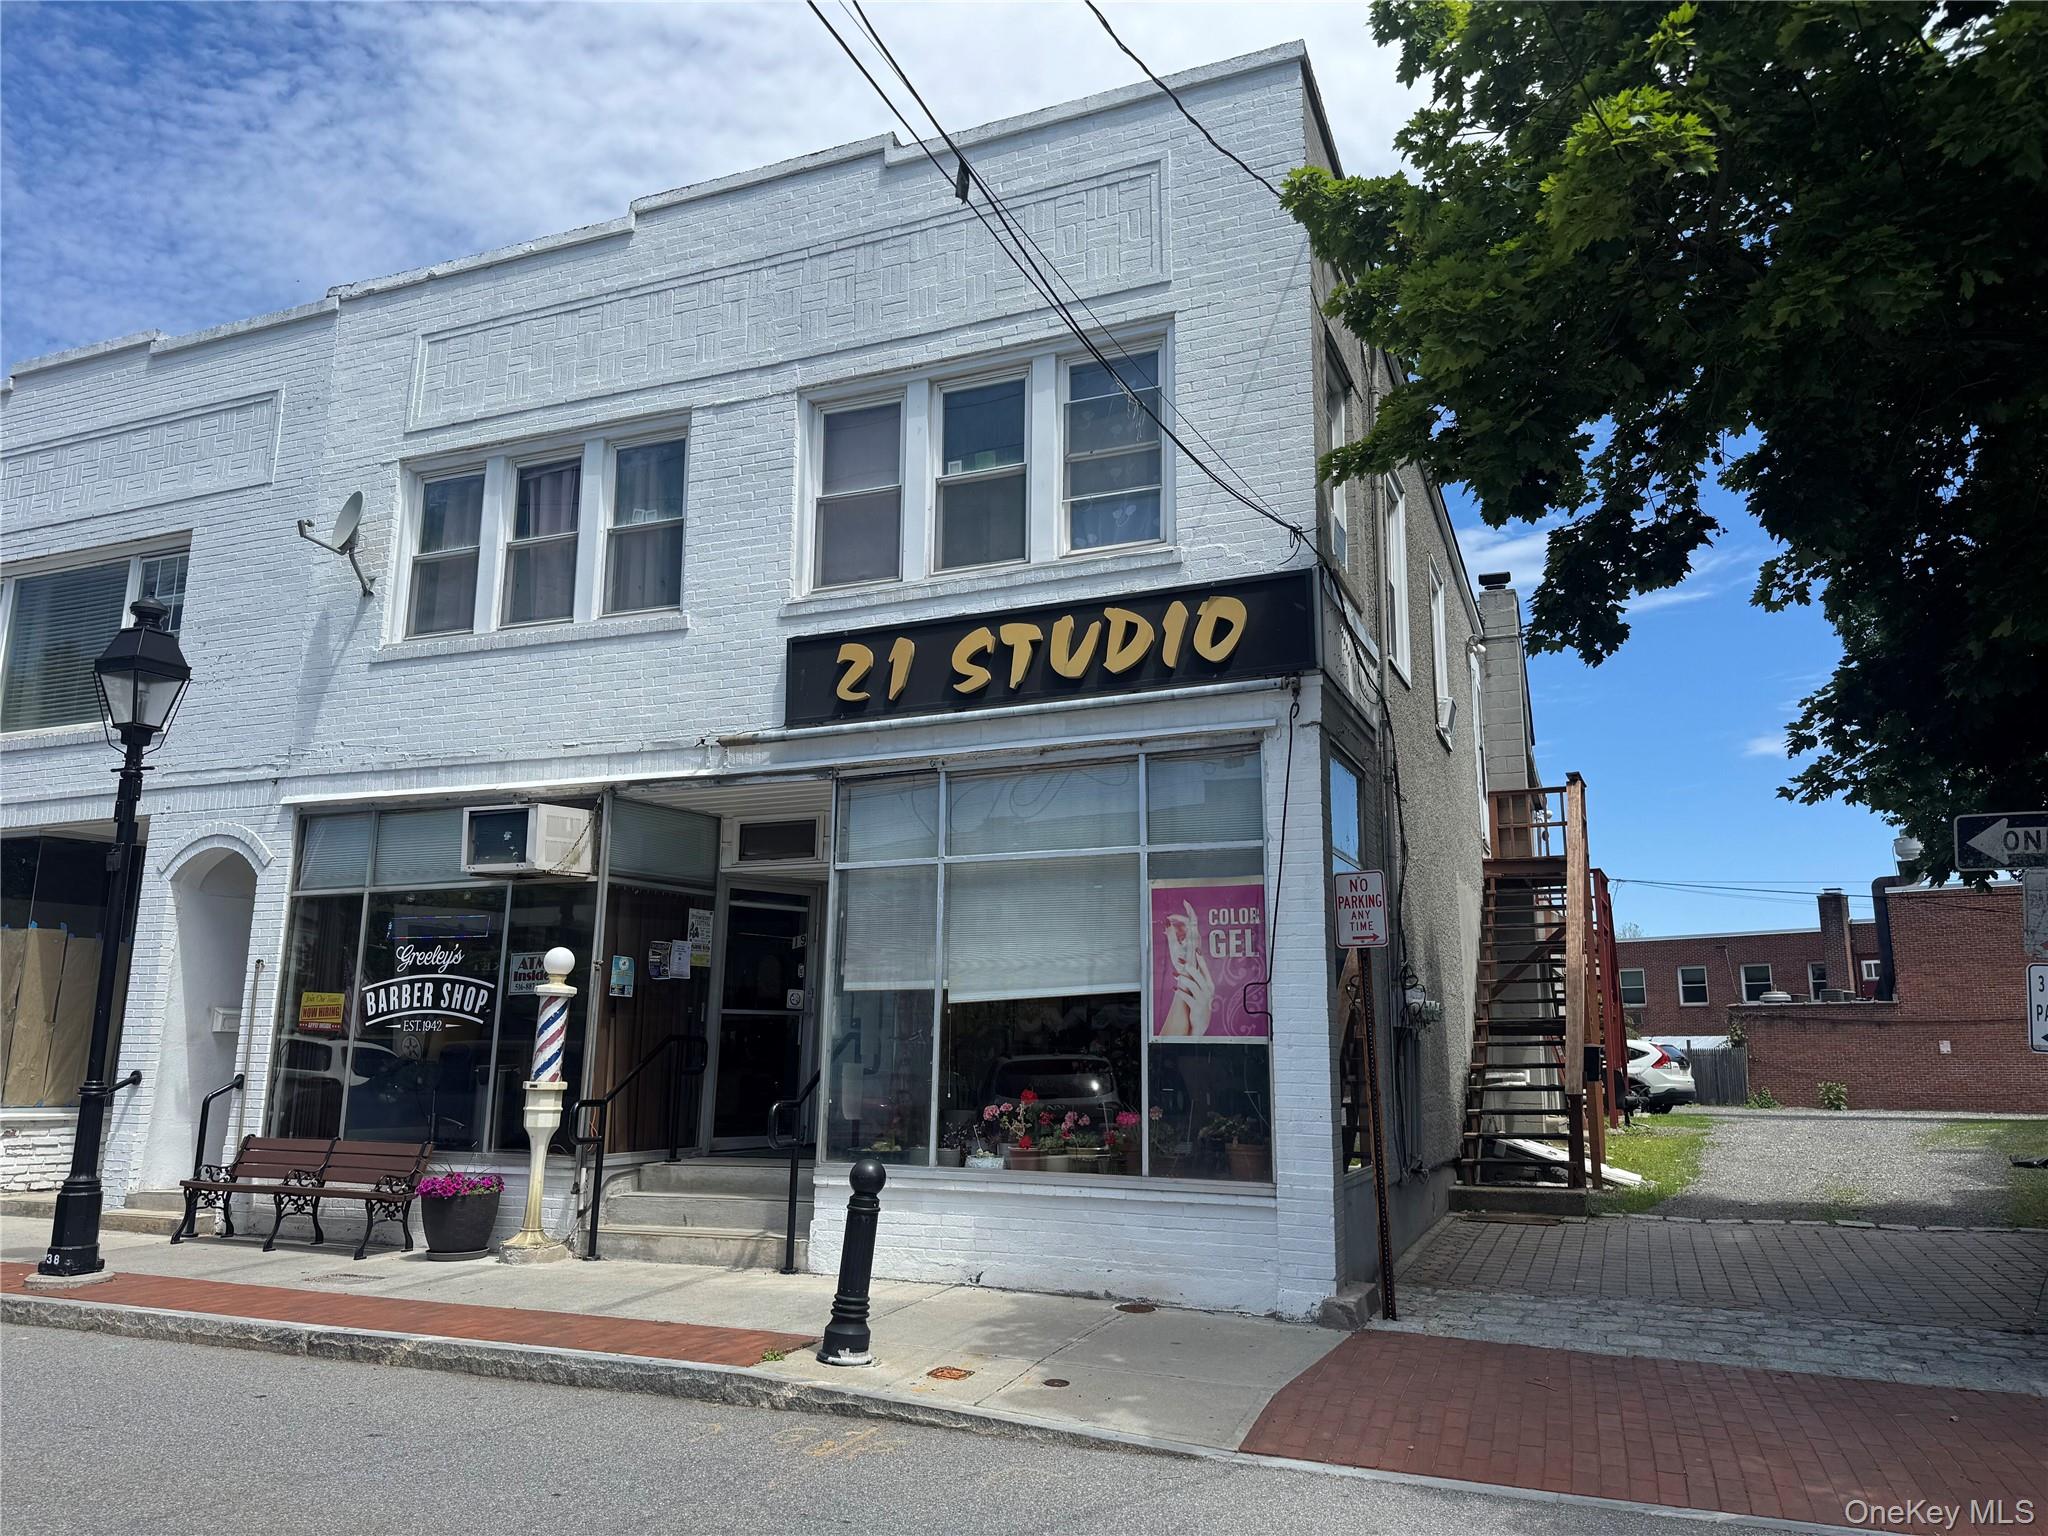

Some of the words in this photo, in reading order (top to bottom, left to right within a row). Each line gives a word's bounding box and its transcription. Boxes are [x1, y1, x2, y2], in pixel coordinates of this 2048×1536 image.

[835, 636, 915, 701] 21
[951, 595, 1248, 694] STUDIO
[2003, 830, 2048, 851] ON
[1349, 878, 1368, 893] NO
[1338, 894, 1382, 910] PARKING
[1208, 907, 1260, 926] COLOR
[1351, 910, 1371, 920] ANY
[1349, 921, 1374, 931] TIME
[1208, 928, 1260, 959] GEL
[395, 943, 465, 974] Greeley's
[2038, 975, 2045, 993] 3
[366, 982, 434, 1017] BARBER
[440, 982, 489, 1014] SHOP
[302, 1007, 318, 1018] NOW
[318, 1006, 340, 1017] HIRING
[46, 1253, 60, 1265] 38
